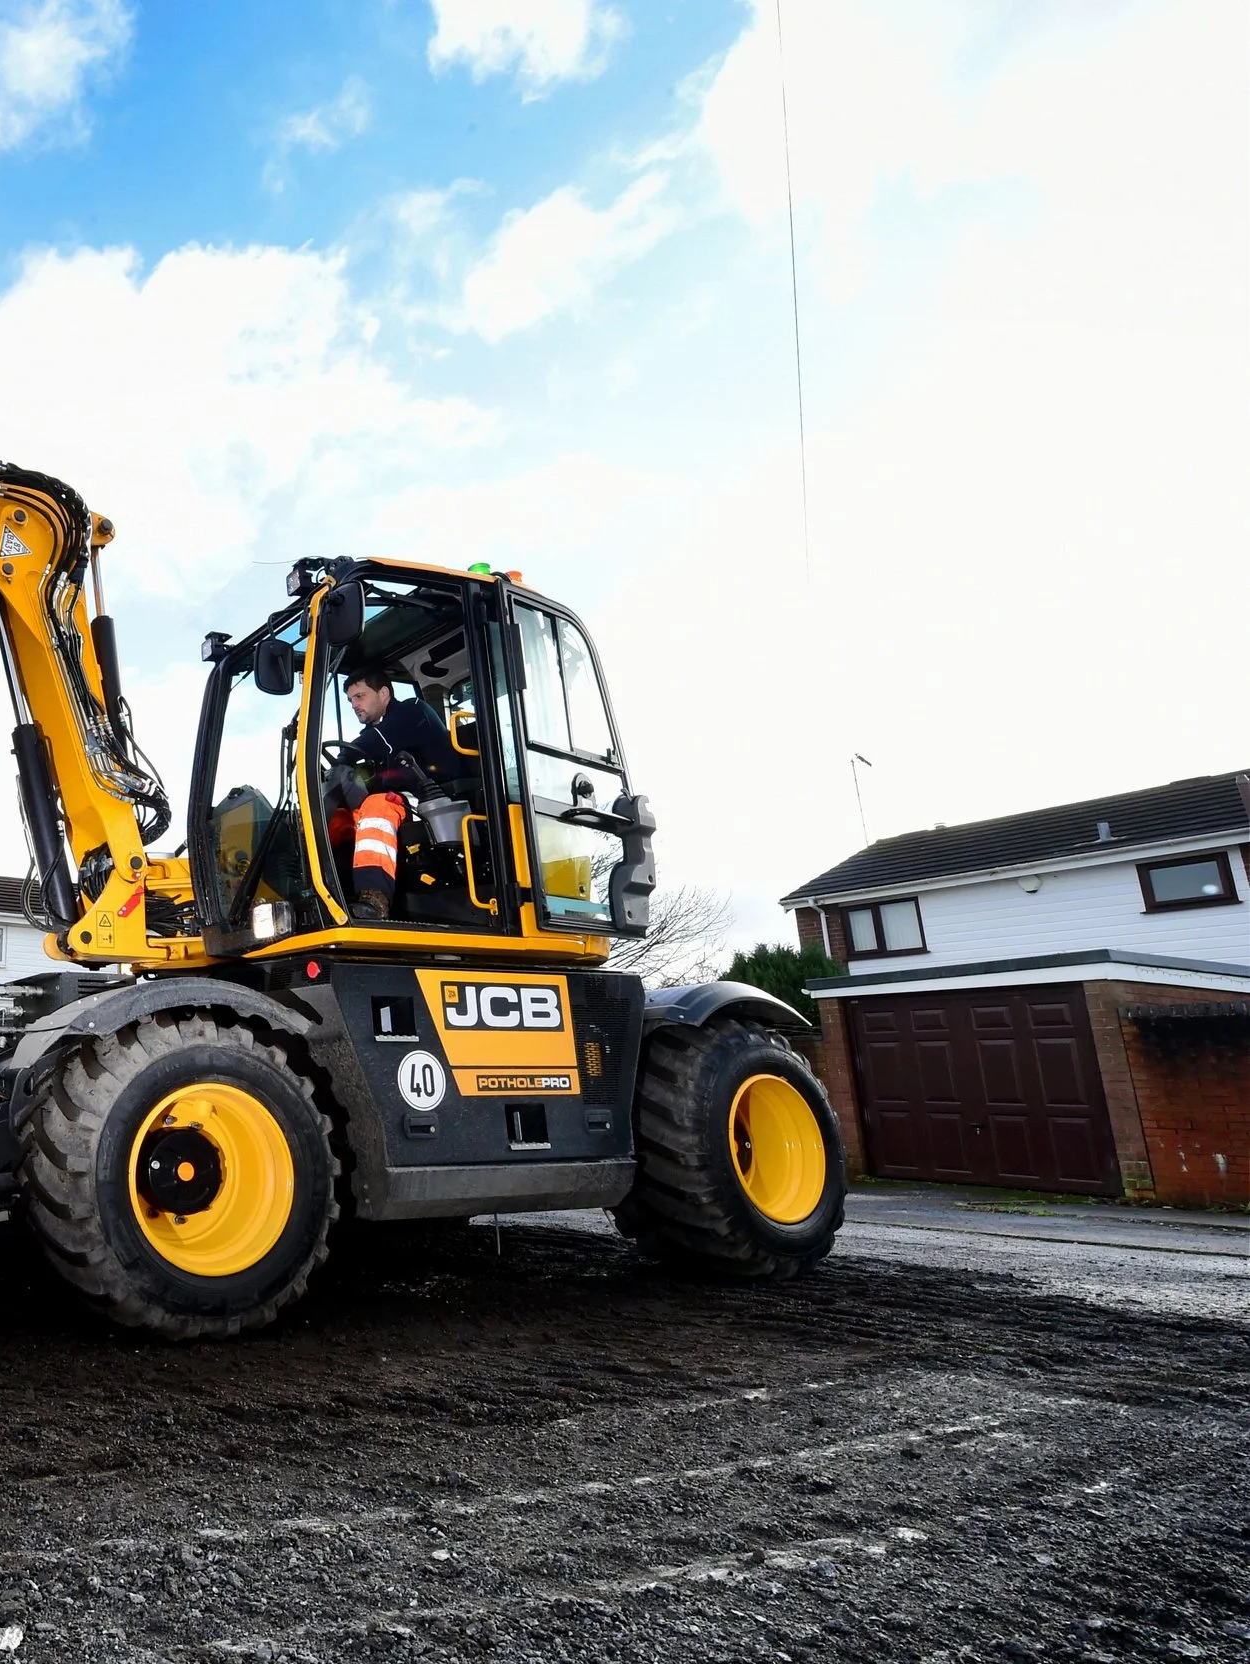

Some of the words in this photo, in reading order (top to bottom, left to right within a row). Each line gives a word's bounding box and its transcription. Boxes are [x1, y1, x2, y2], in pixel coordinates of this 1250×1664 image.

[446, 986, 561, 1028] JCB
[410, 1064, 435, 1097] 40
[478, 1077, 570, 1089] POTHOLEPRO
